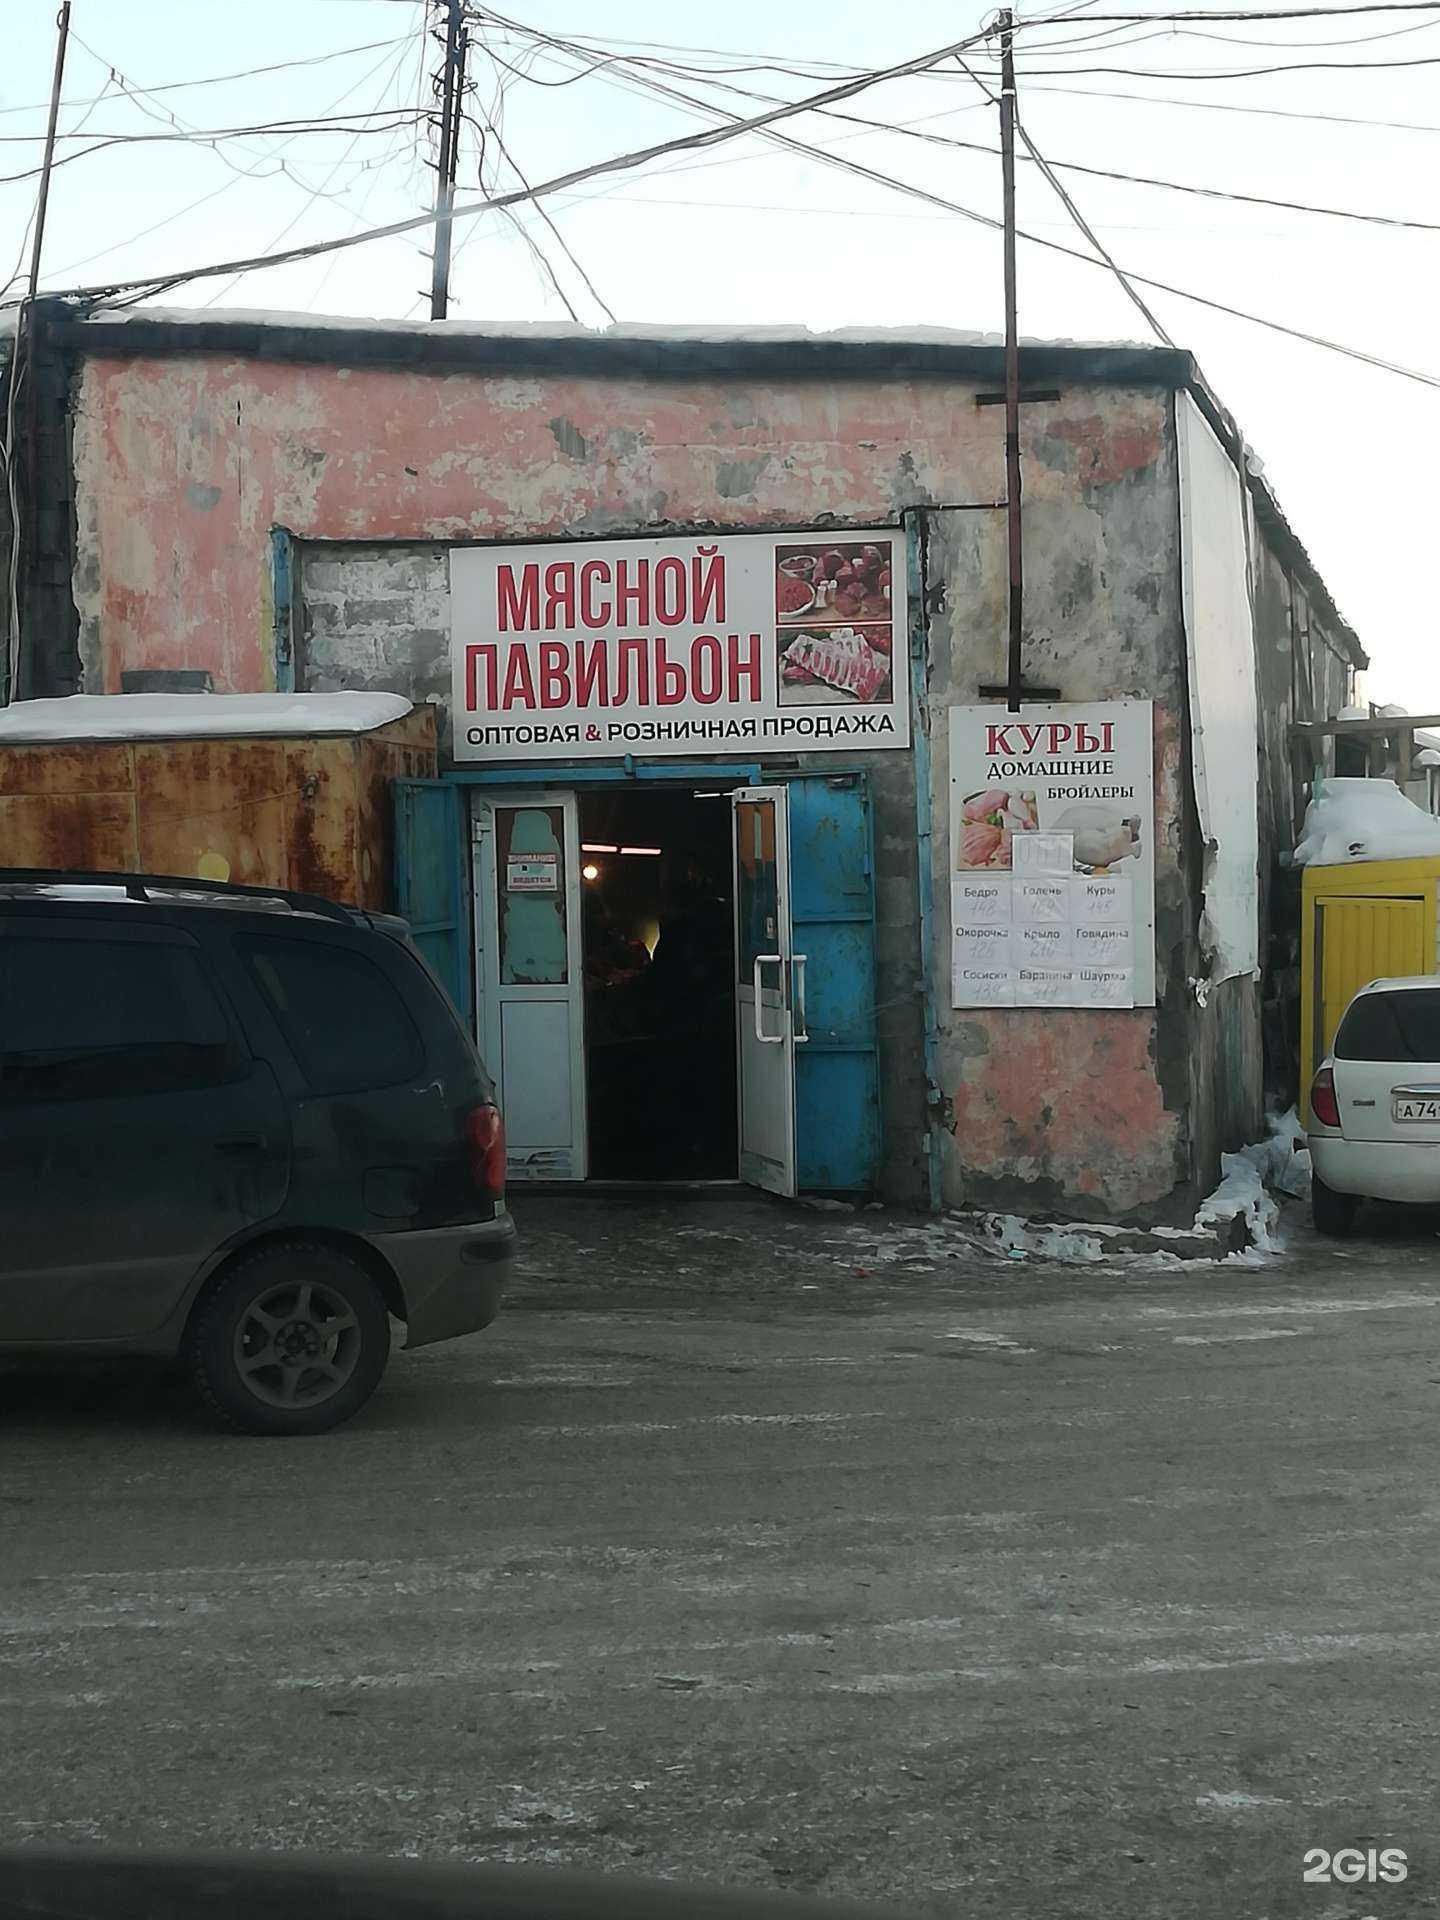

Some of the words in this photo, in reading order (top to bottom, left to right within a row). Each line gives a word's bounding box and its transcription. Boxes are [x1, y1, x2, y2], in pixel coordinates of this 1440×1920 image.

[497, 545, 726, 632] МЯСНОЙ
[465, 633, 762, 712] ПАВИЛЬОН
[467, 724, 579, 745] ОПТОВАЯ
[585, 724, 602, 741] &
[607, 719, 756, 741] РОЗНИЧНАЯ
[763, 714, 895, 738] ПРОДАЖА
[985, 722, 1115, 756] КУРЫ
[987, 760, 1114, 780] ДОМАШНИЕ
[1047, 785, 1135, 799] БРОЙЛЕРЫ
[964, 888, 998, 898] Бедро
[1023, 886, 1062, 896] Голень
[1087, 885, 1115, 897] Куры
[956, 927, 1008, 939] Окорочка
[1024, 929, 1060, 940] Крыло
[1077, 928, 1129, 940] Говядина
[963, 971, 1008, 980] Сосиски
[1020, 970, 1072, 982] Баранина
[1080, 971, 1126, 983] Шаурма
